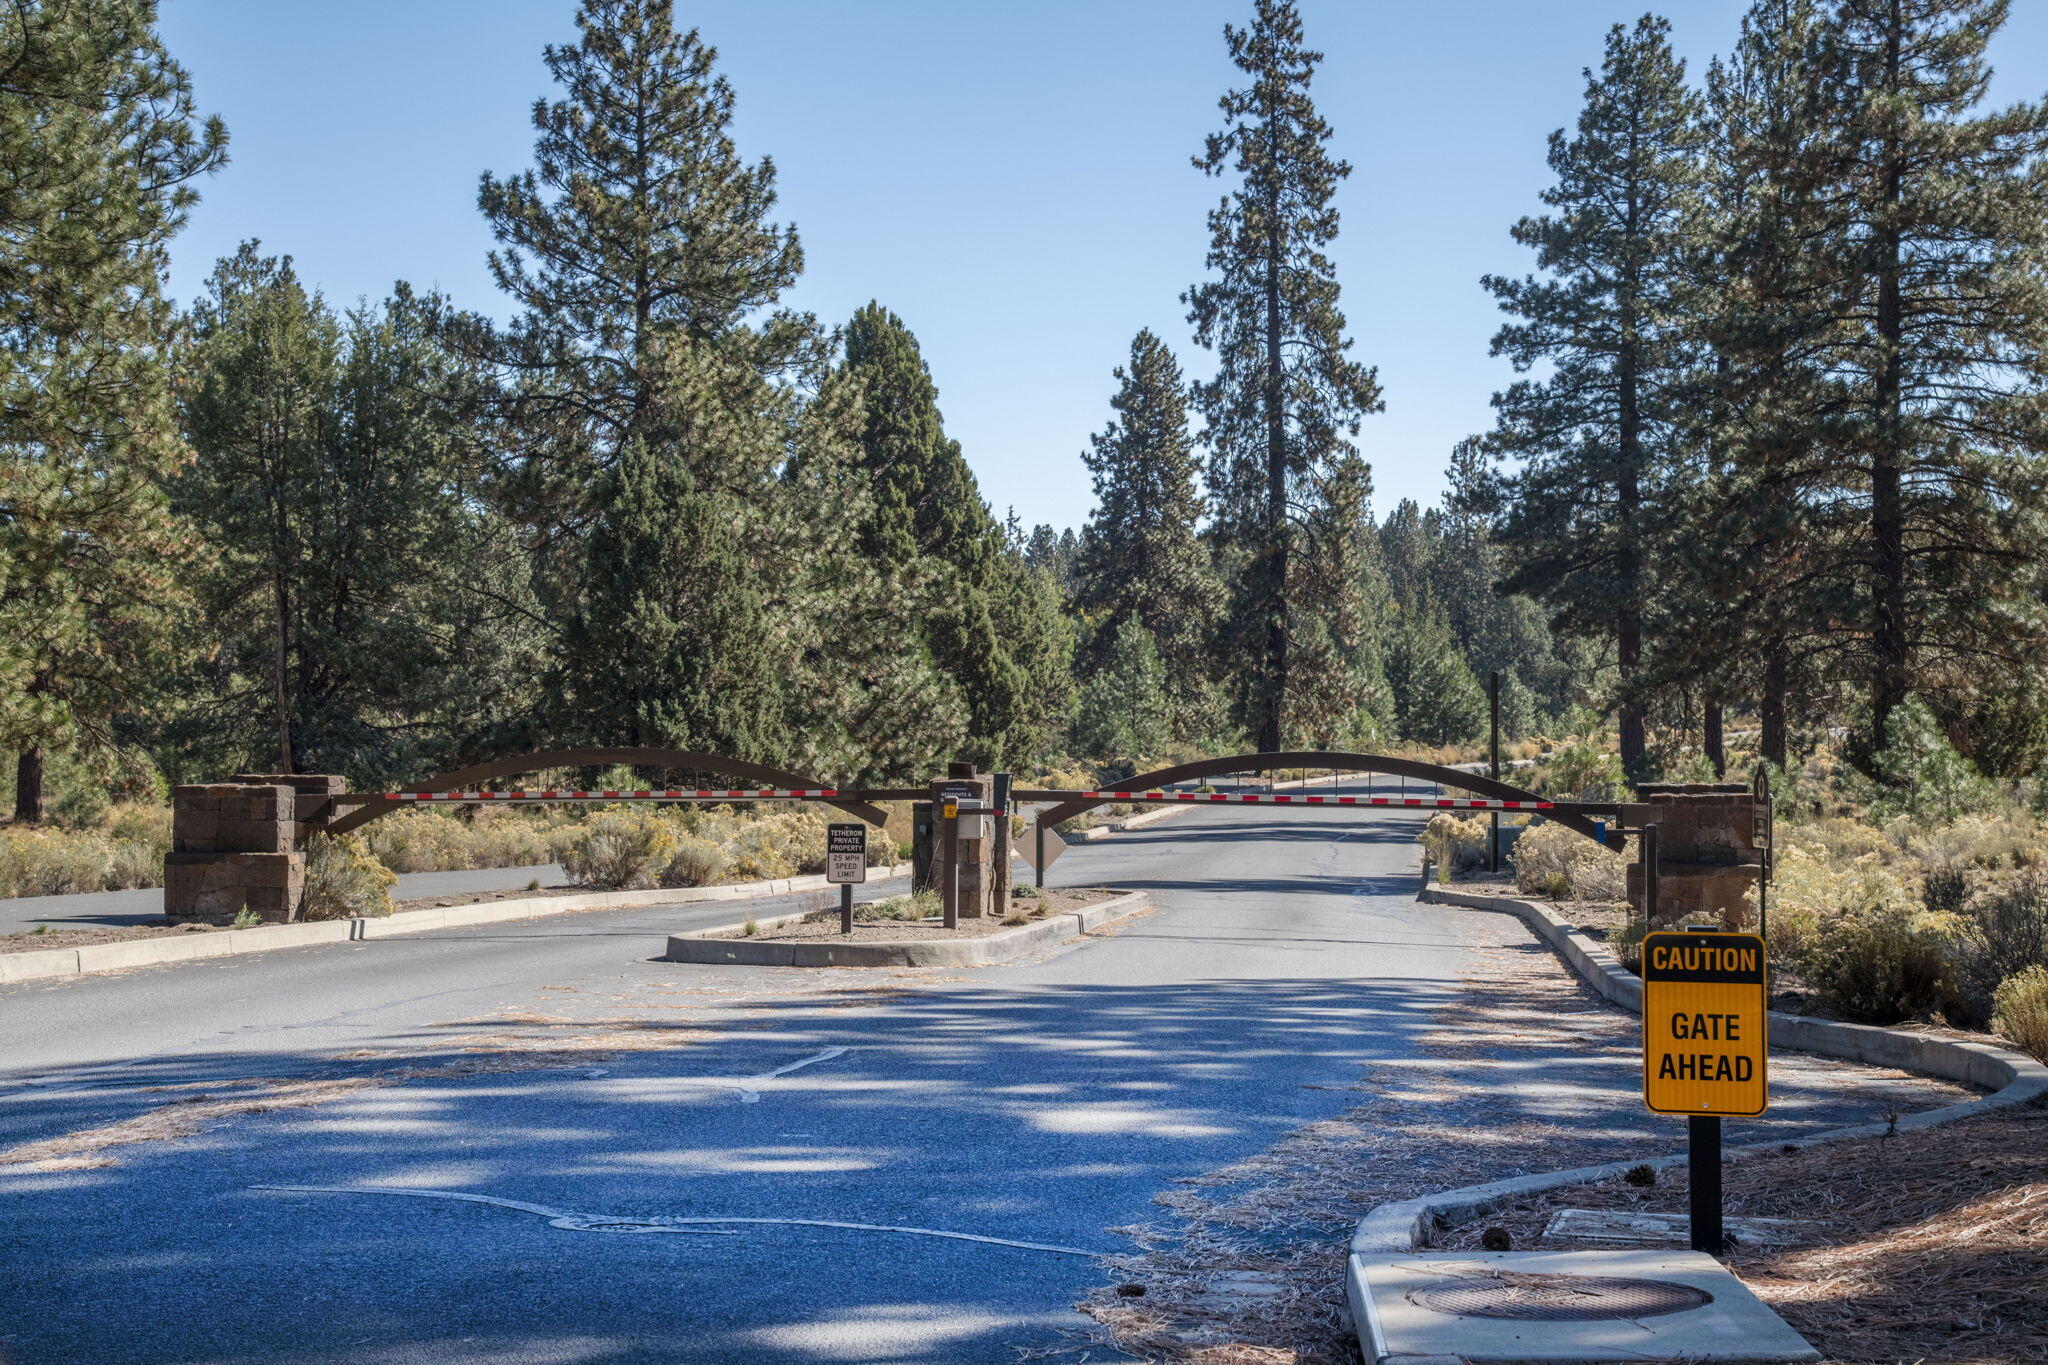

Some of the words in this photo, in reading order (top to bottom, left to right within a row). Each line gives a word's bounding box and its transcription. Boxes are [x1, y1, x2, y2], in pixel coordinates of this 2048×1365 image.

[1652, 946, 1756, 972] CAUTION
[1671, 1012, 1740, 1041] GATE
[1658, 1053, 1753, 1082] AHEAD
